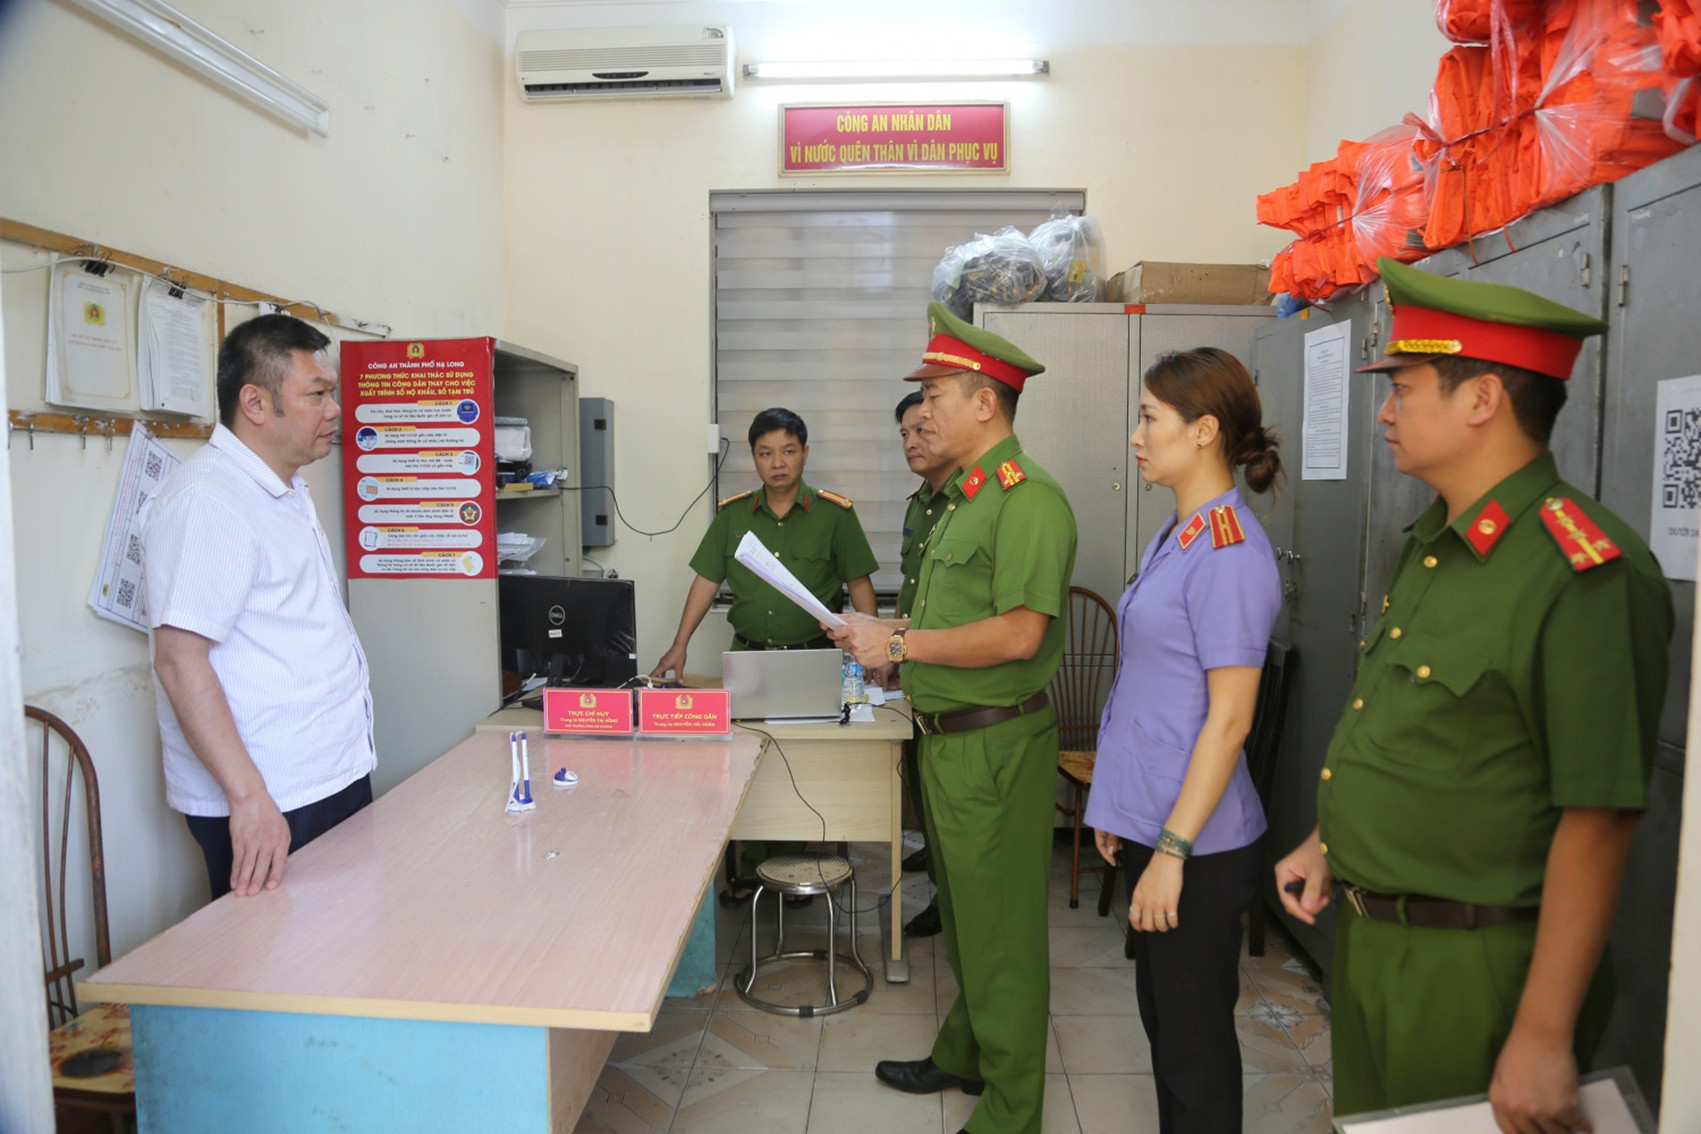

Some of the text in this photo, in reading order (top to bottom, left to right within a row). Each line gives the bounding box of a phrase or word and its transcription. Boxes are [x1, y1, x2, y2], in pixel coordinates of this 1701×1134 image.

[836, 110, 952, 132] CÔNG AN NHÂN DÂN
[790, 139, 998, 164] VÌ NƯỚC QUÊN THÂN VÌ DÂN PHỤC VỤ
